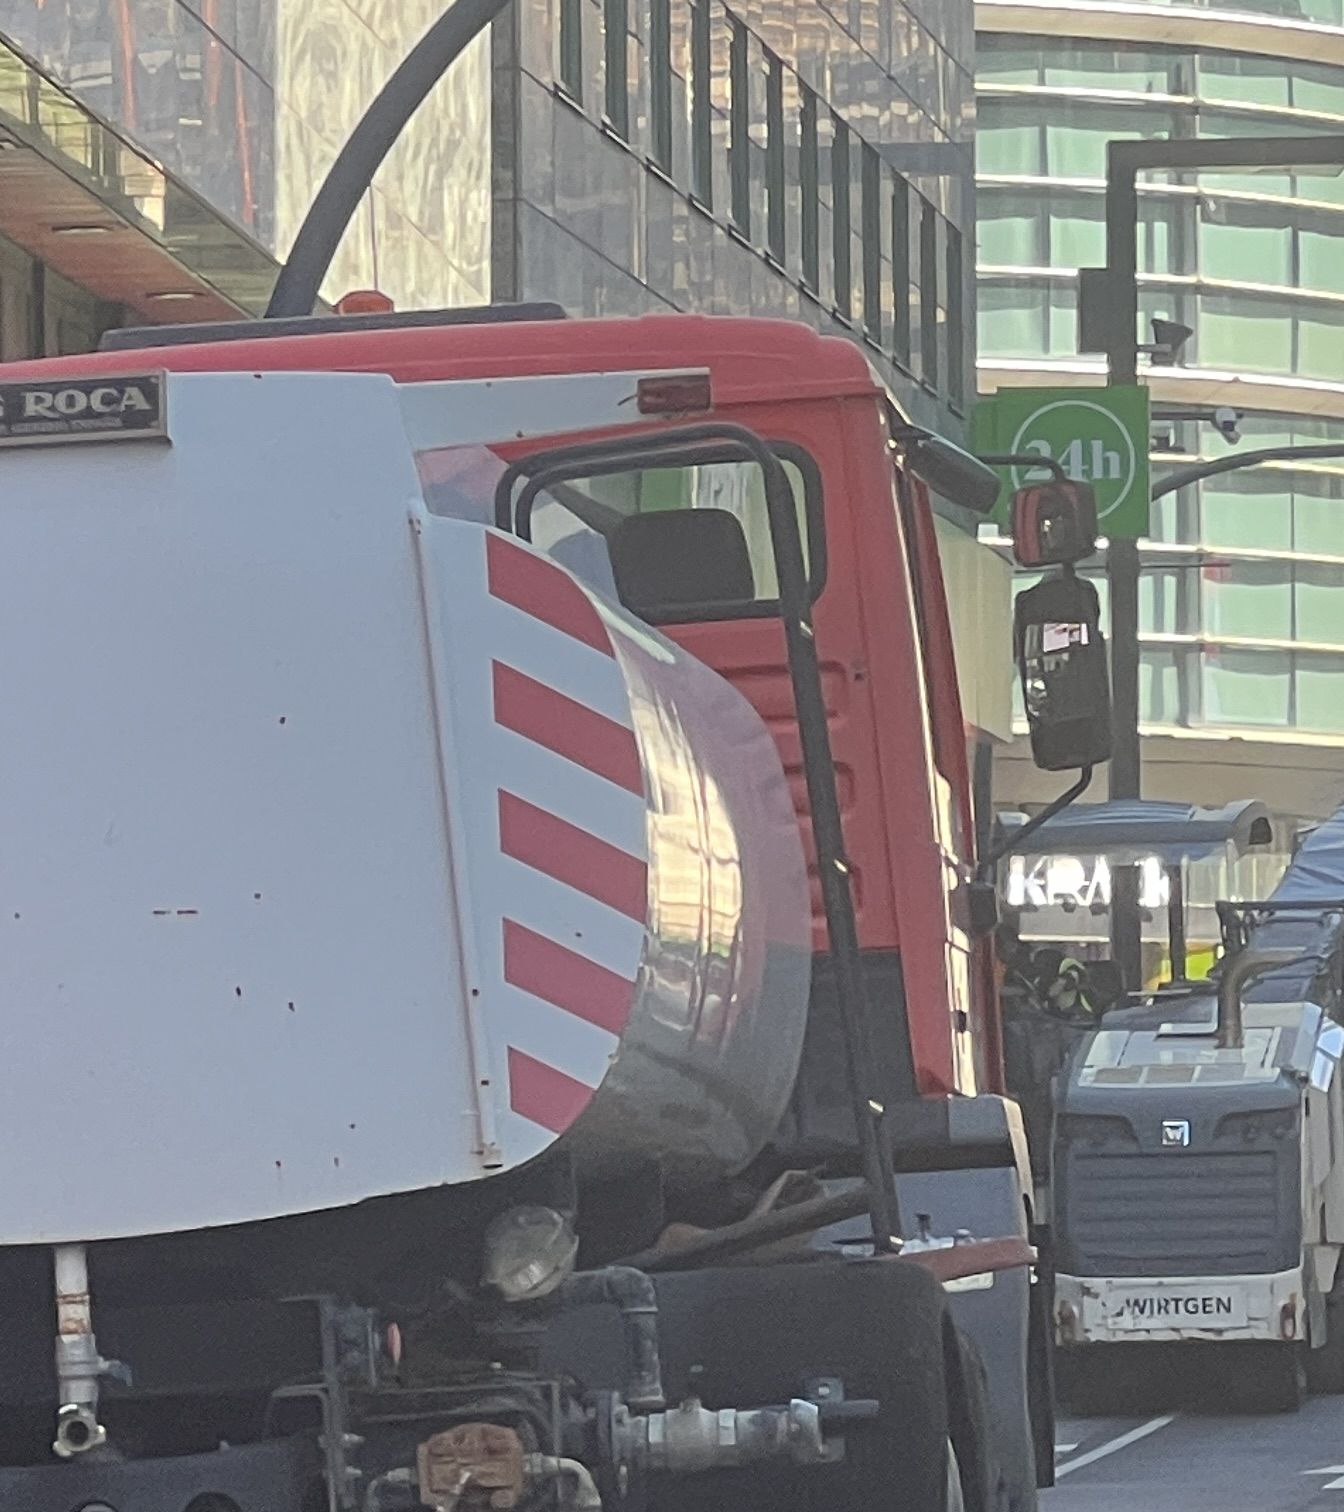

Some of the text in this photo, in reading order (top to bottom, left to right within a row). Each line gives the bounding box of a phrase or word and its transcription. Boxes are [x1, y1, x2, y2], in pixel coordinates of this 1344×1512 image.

[24, 386, 152, 418] ROCA
[1023, 438, 1122, 482] 24h
[1125, 1296, 1232, 1316] WIRTGEN
